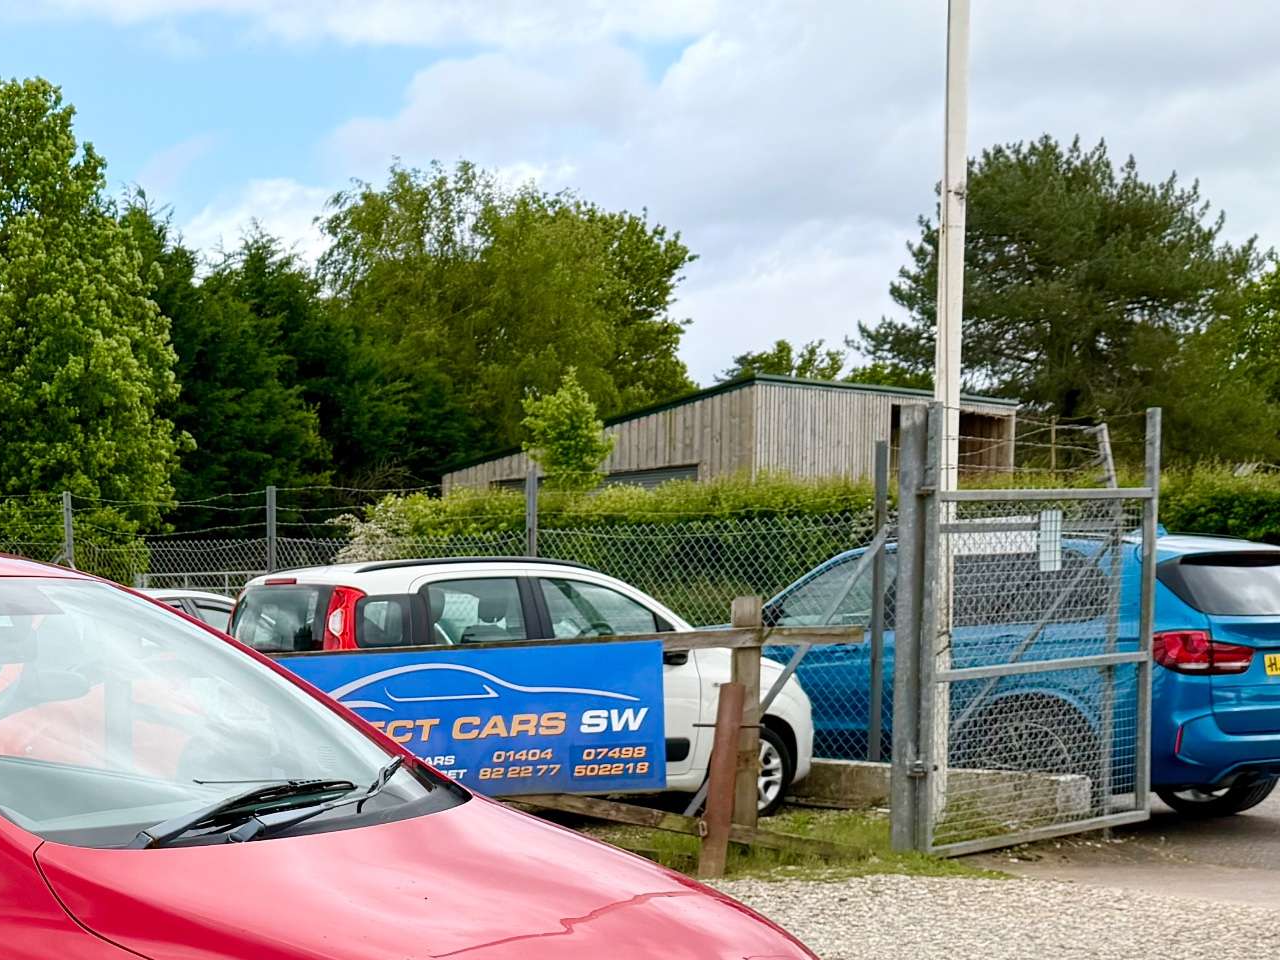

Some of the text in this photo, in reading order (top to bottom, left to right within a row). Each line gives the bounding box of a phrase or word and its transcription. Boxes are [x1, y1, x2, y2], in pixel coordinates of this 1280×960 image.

[452, 712, 567, 740] CARS
[580, 707, 649, 734] SW
[419, 756, 455, 766] ARS
[492, 749, 553, 763] 01404
[583, 746, 647, 761] 07498
[574, 761, 650, 776] 502218
